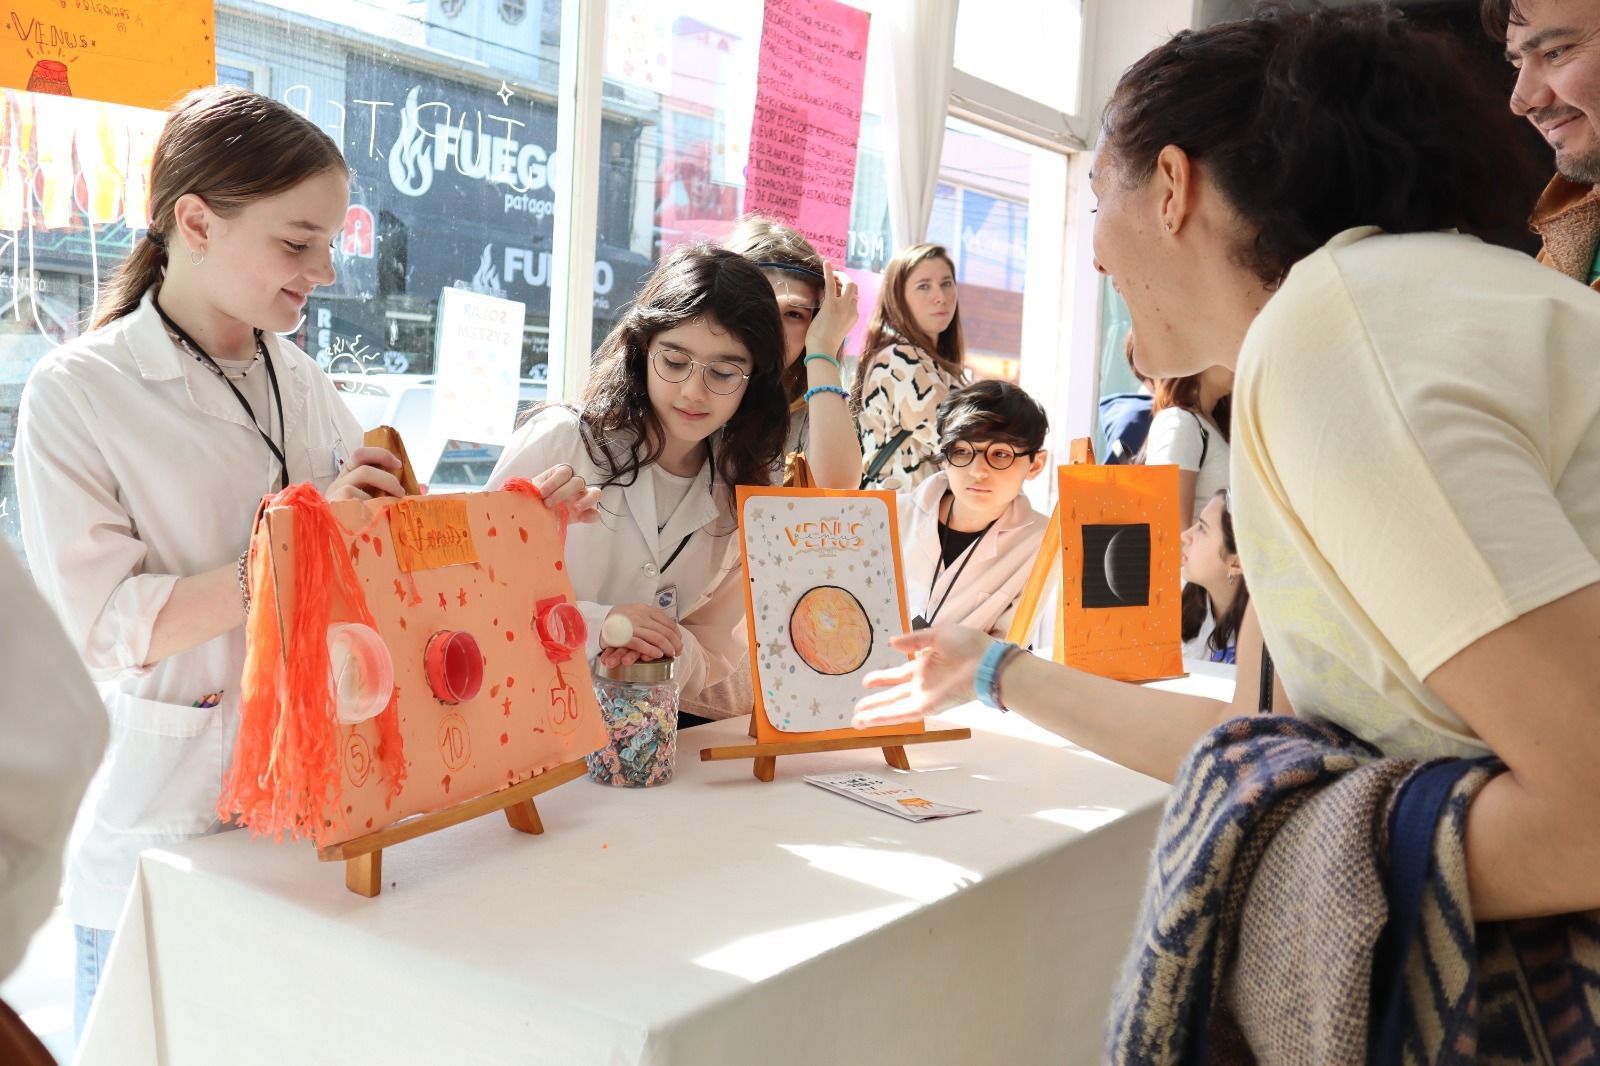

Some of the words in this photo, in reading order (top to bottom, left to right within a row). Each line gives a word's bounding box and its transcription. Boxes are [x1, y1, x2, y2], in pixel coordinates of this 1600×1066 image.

[11, 12, 88, 48] VENUS
[504, 193, 554, 220] patago
[784, 520, 865, 548] VENUS
[350, 744, 364, 774] 5
